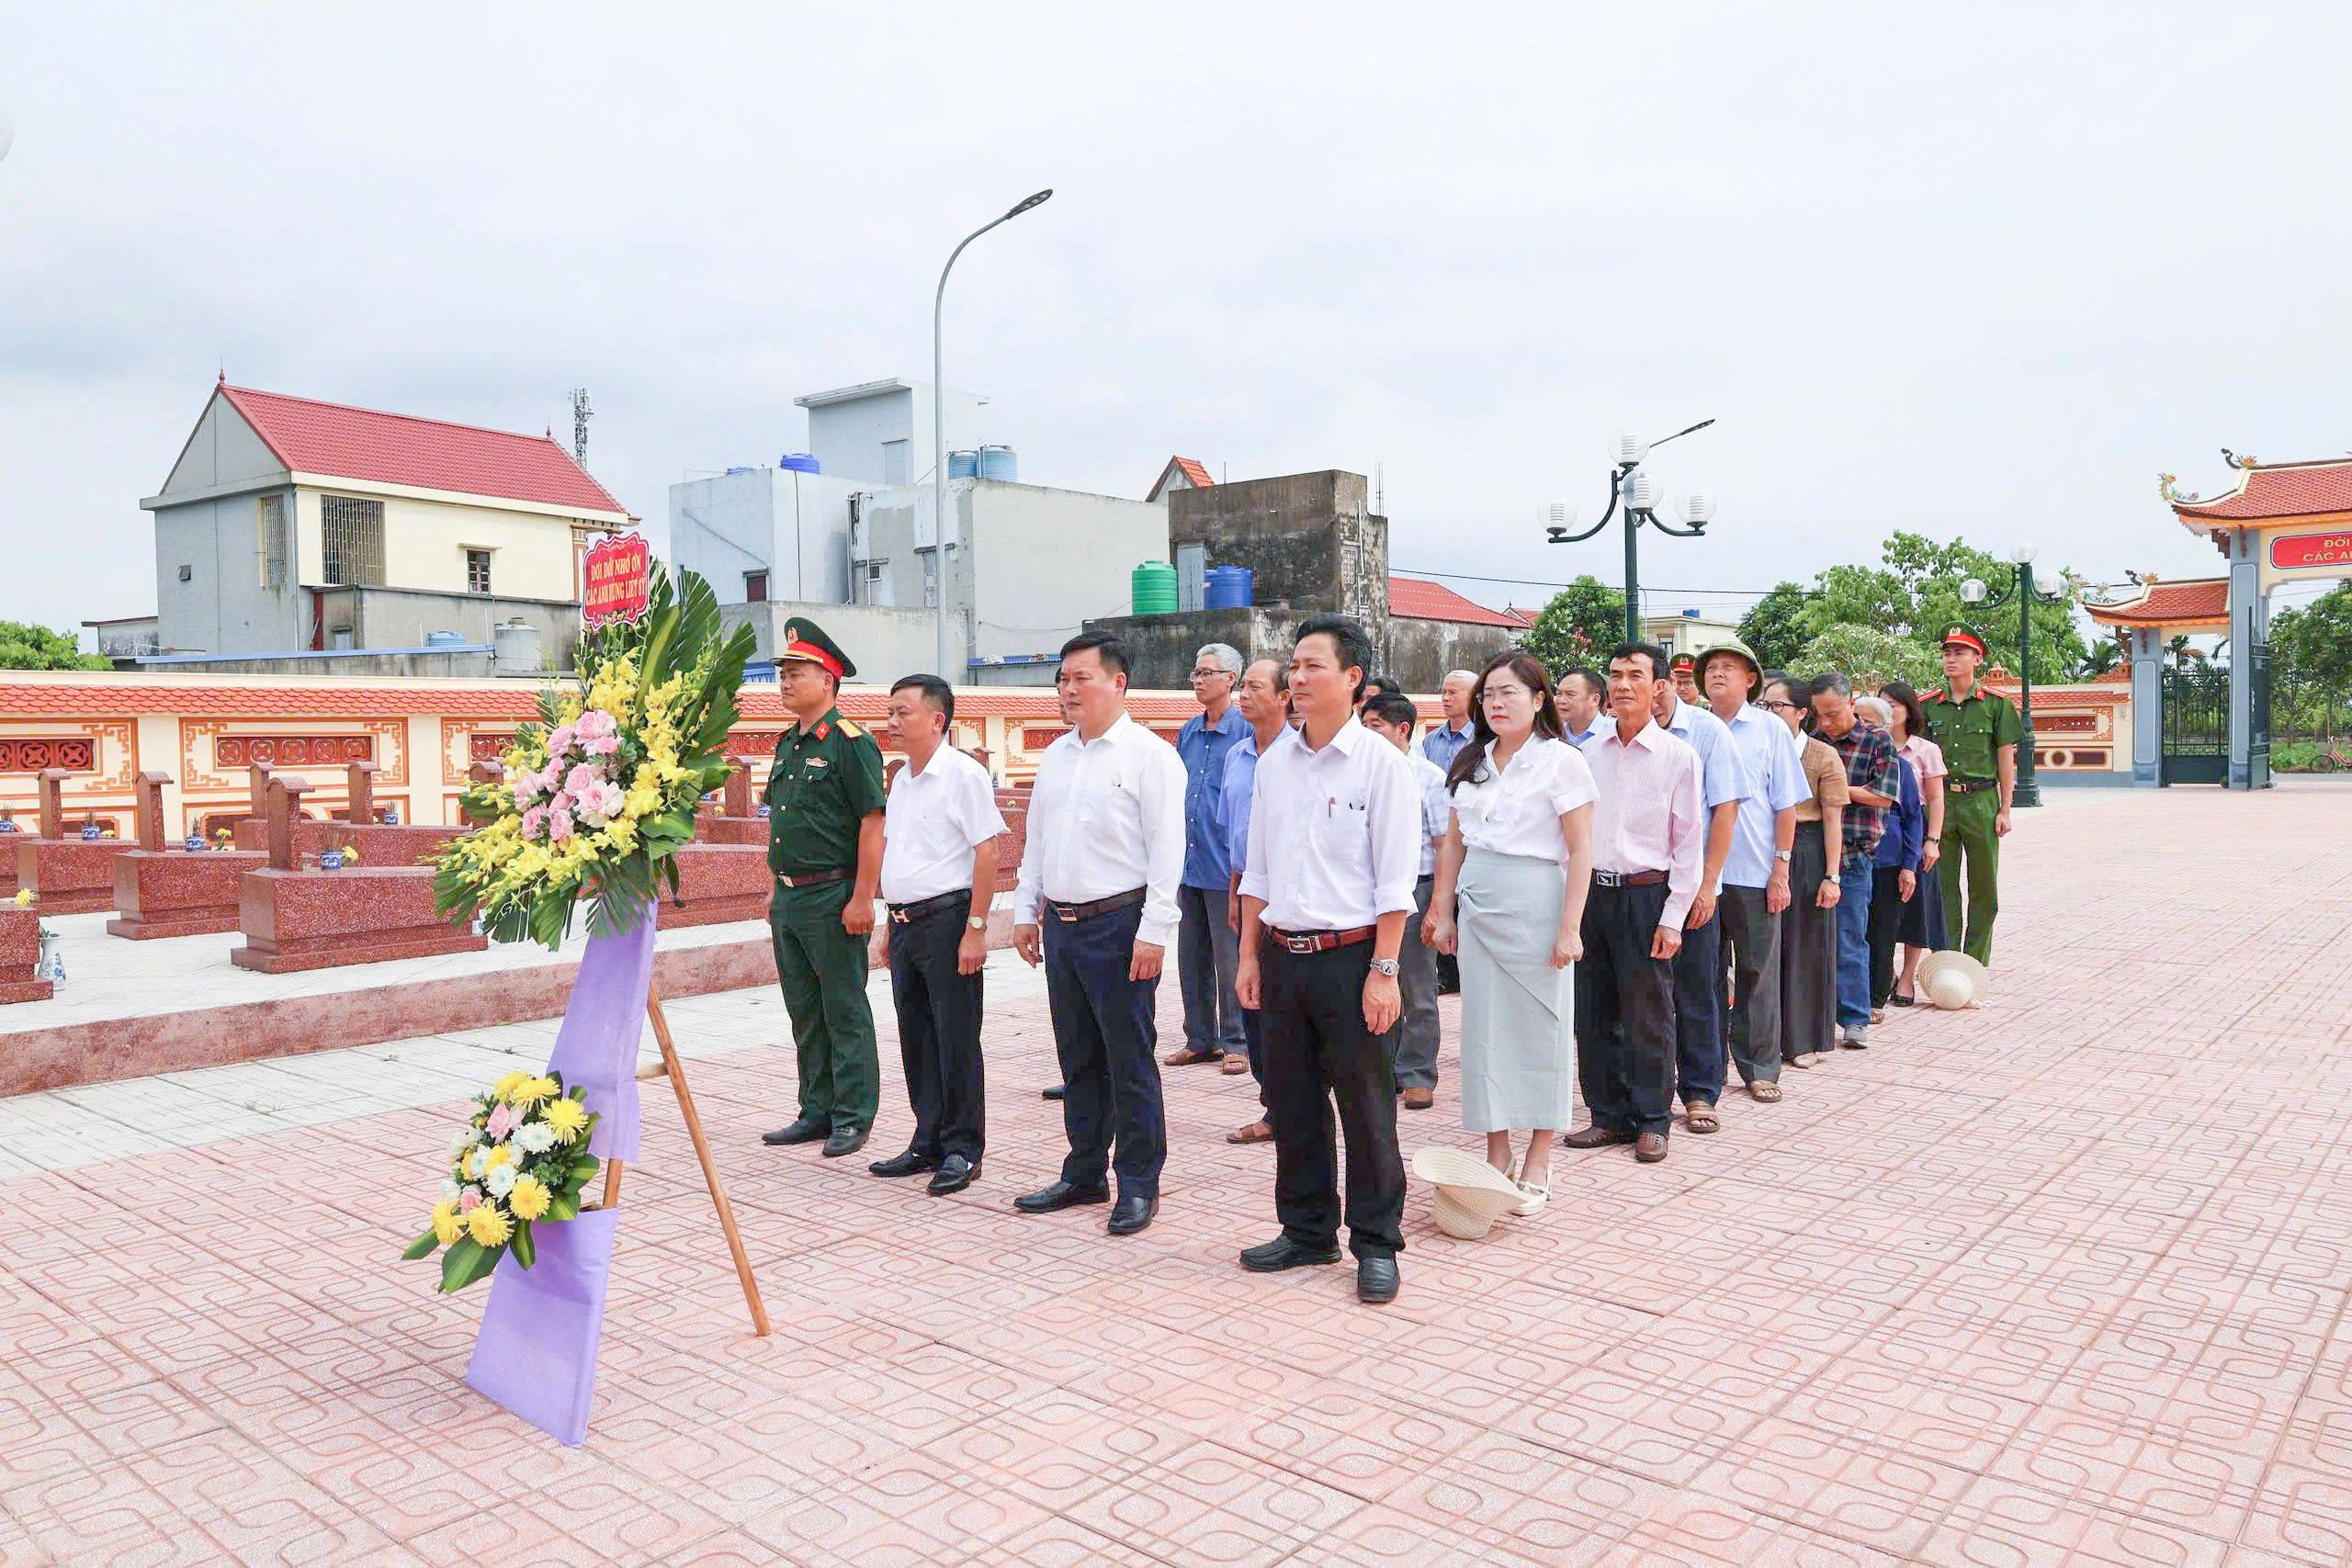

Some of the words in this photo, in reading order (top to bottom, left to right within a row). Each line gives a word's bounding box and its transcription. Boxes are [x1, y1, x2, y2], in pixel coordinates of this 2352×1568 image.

[2324, 536, 2351, 548] ĐỜI
[2303, 550, 2335, 562] CÁC
[2339, 550, 2352, 559] A
[586, 583, 597, 606] CÁC
[597, 584, 608, 604] ANH
[608, 578, 625, 602] HÙNG
[626, 574, 638, 603] LIỆT
